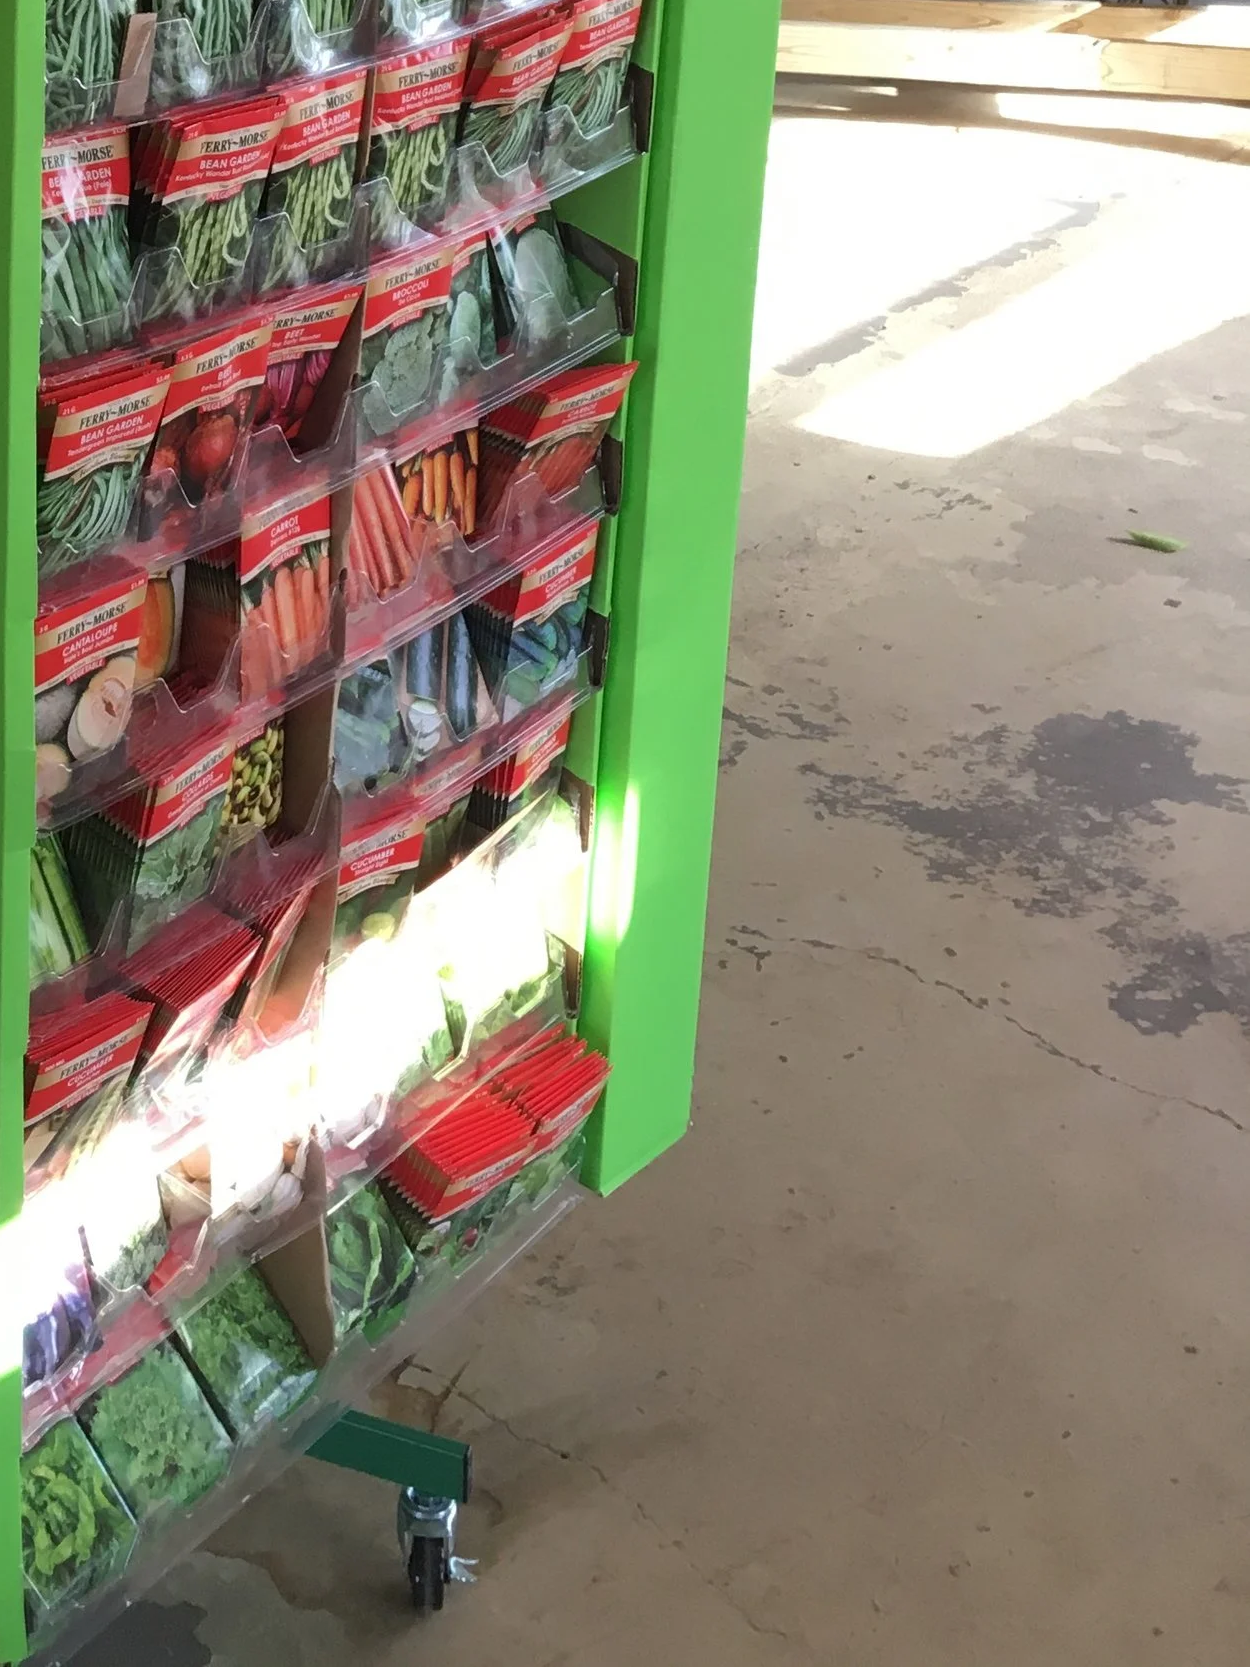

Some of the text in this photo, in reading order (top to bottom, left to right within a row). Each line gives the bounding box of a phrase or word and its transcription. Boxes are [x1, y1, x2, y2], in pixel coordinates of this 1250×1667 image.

[589, 28, 606, 41] BEAN
[402, 91, 422, 104] BEAN
[422, 81, 452, 98] GARDEN
[303, 110, 351, 136] BEAN GARDEN
[199, 150, 262, 170] BEAN GARDEN
[174, 170, 204, 182] Kentucky
[285, 329, 305, 340] BEET
[217, 366, 233, 381] BEET
[80, 415, 144, 445] BEAN GARDEN
[270, 515, 299, 538] CARROT
[62, 622, 118, 658] CANTALOUPE
[350, 847, 395, 871] CUCUMBER
